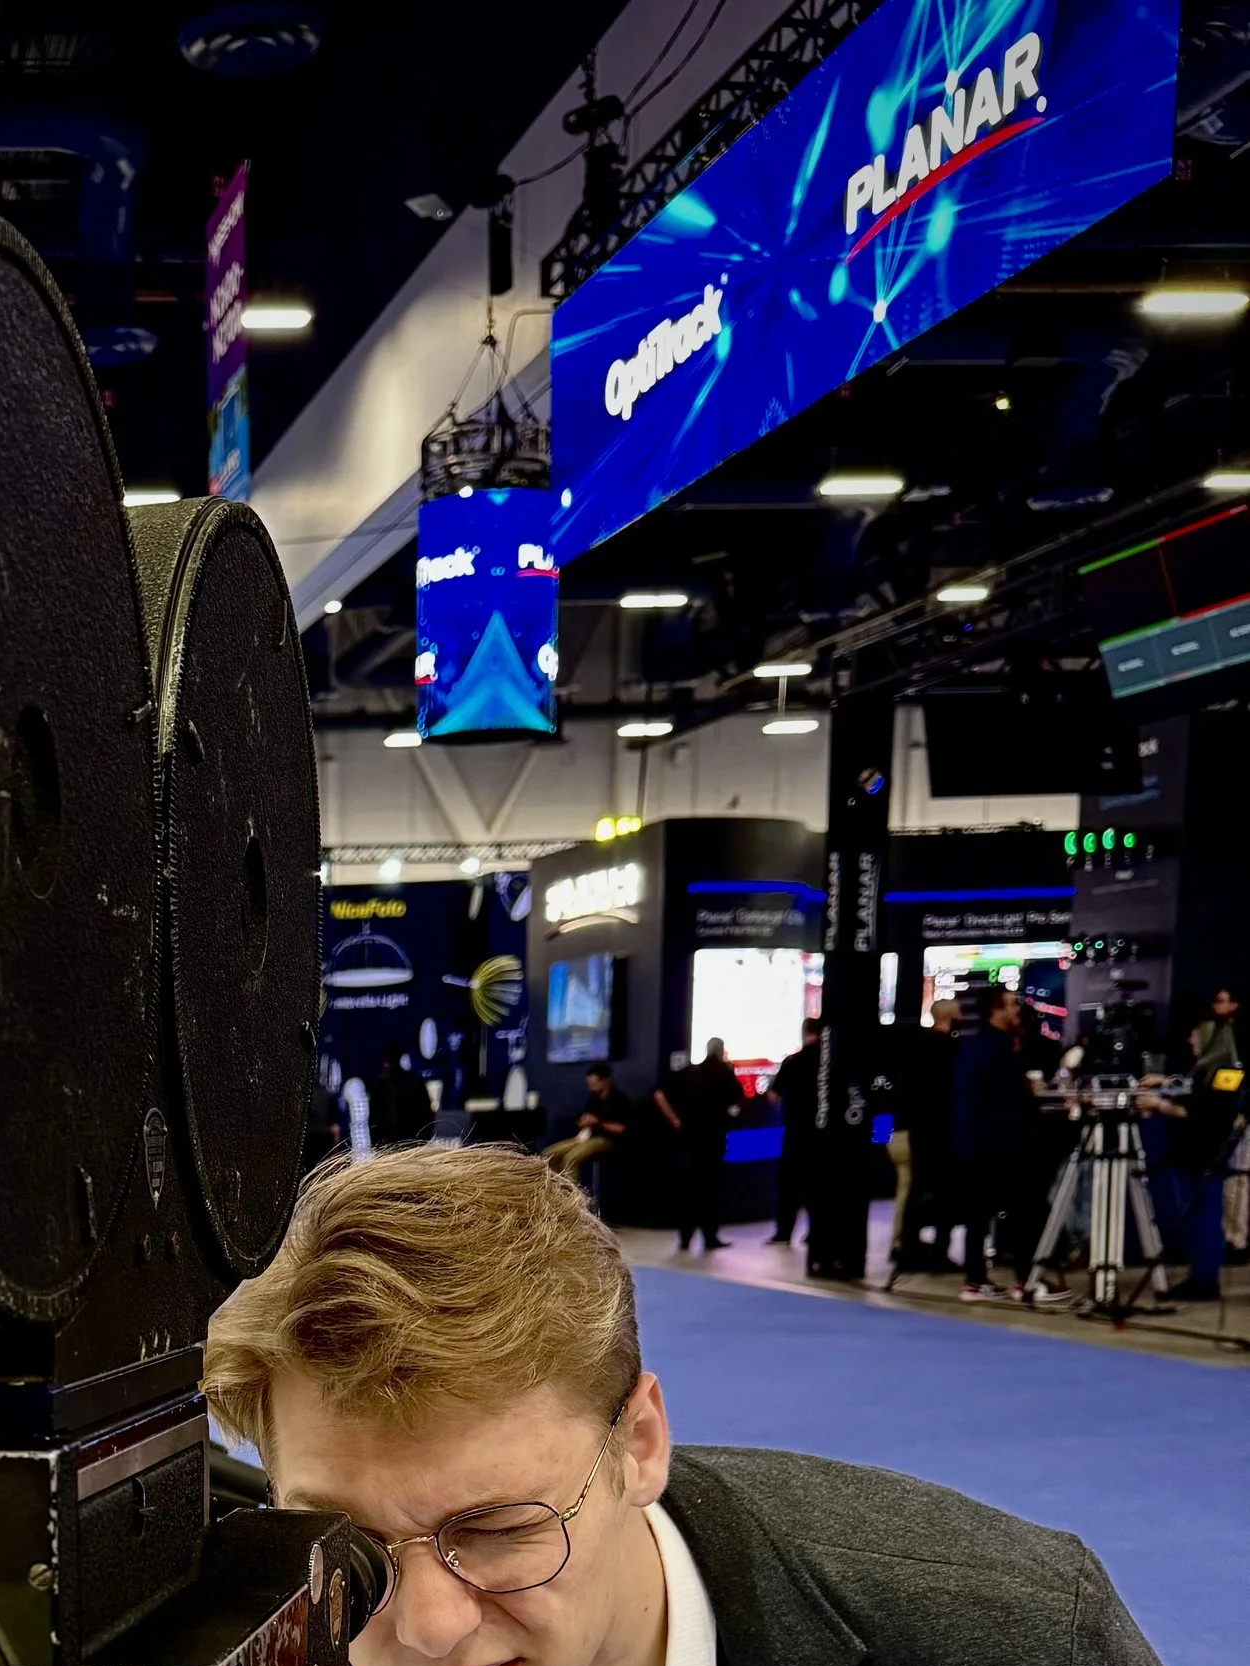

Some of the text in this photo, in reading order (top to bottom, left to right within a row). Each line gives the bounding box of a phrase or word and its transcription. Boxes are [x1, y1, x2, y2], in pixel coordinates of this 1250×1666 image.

[845, 31, 1041, 235] PLANAR
[604, 282, 724, 422] OptiTrack
[853, 851, 877, 952] PLANAR
